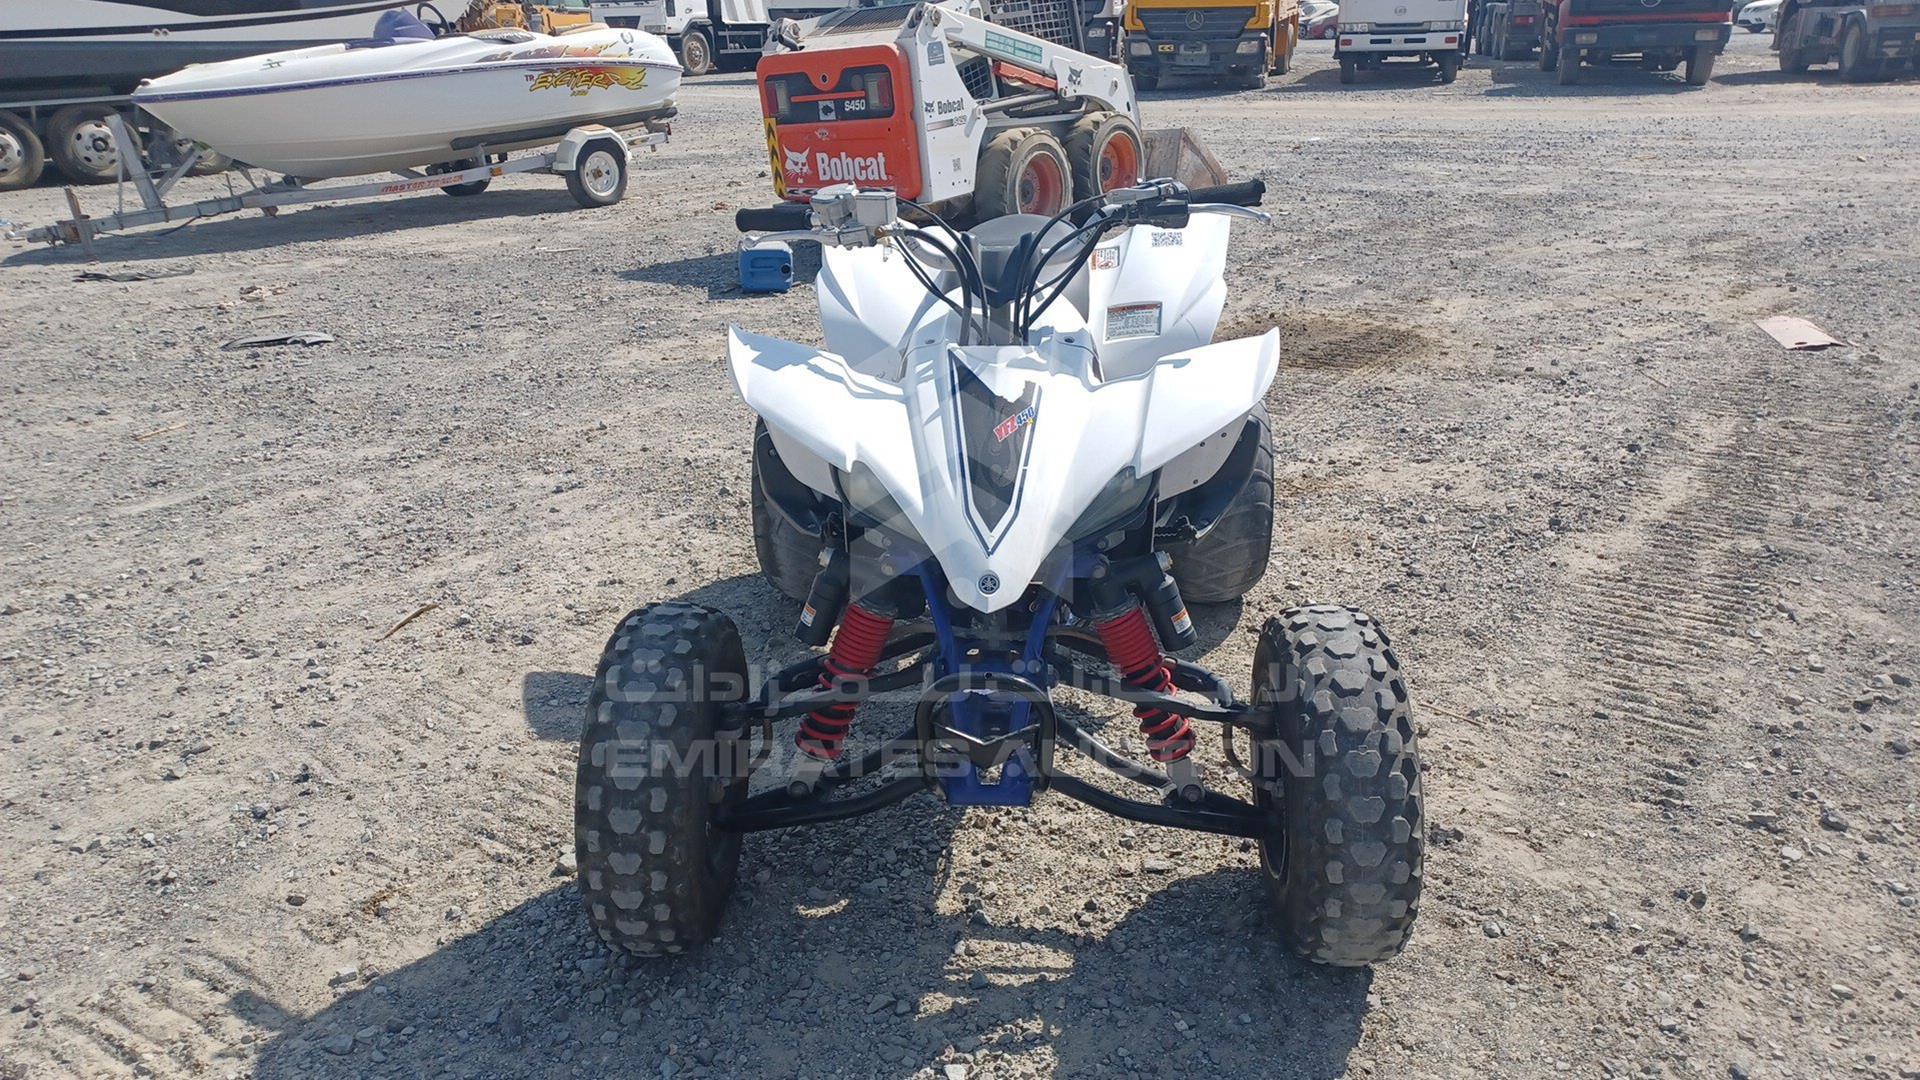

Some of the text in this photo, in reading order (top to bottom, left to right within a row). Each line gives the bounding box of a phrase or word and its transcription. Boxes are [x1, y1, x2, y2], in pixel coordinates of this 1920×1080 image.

[530, 70, 615, 91] EXCITER
[843, 99, 866, 111] S450
[937, 98, 965, 115] Bobcat
[816, 152, 888, 181] Bobcat
